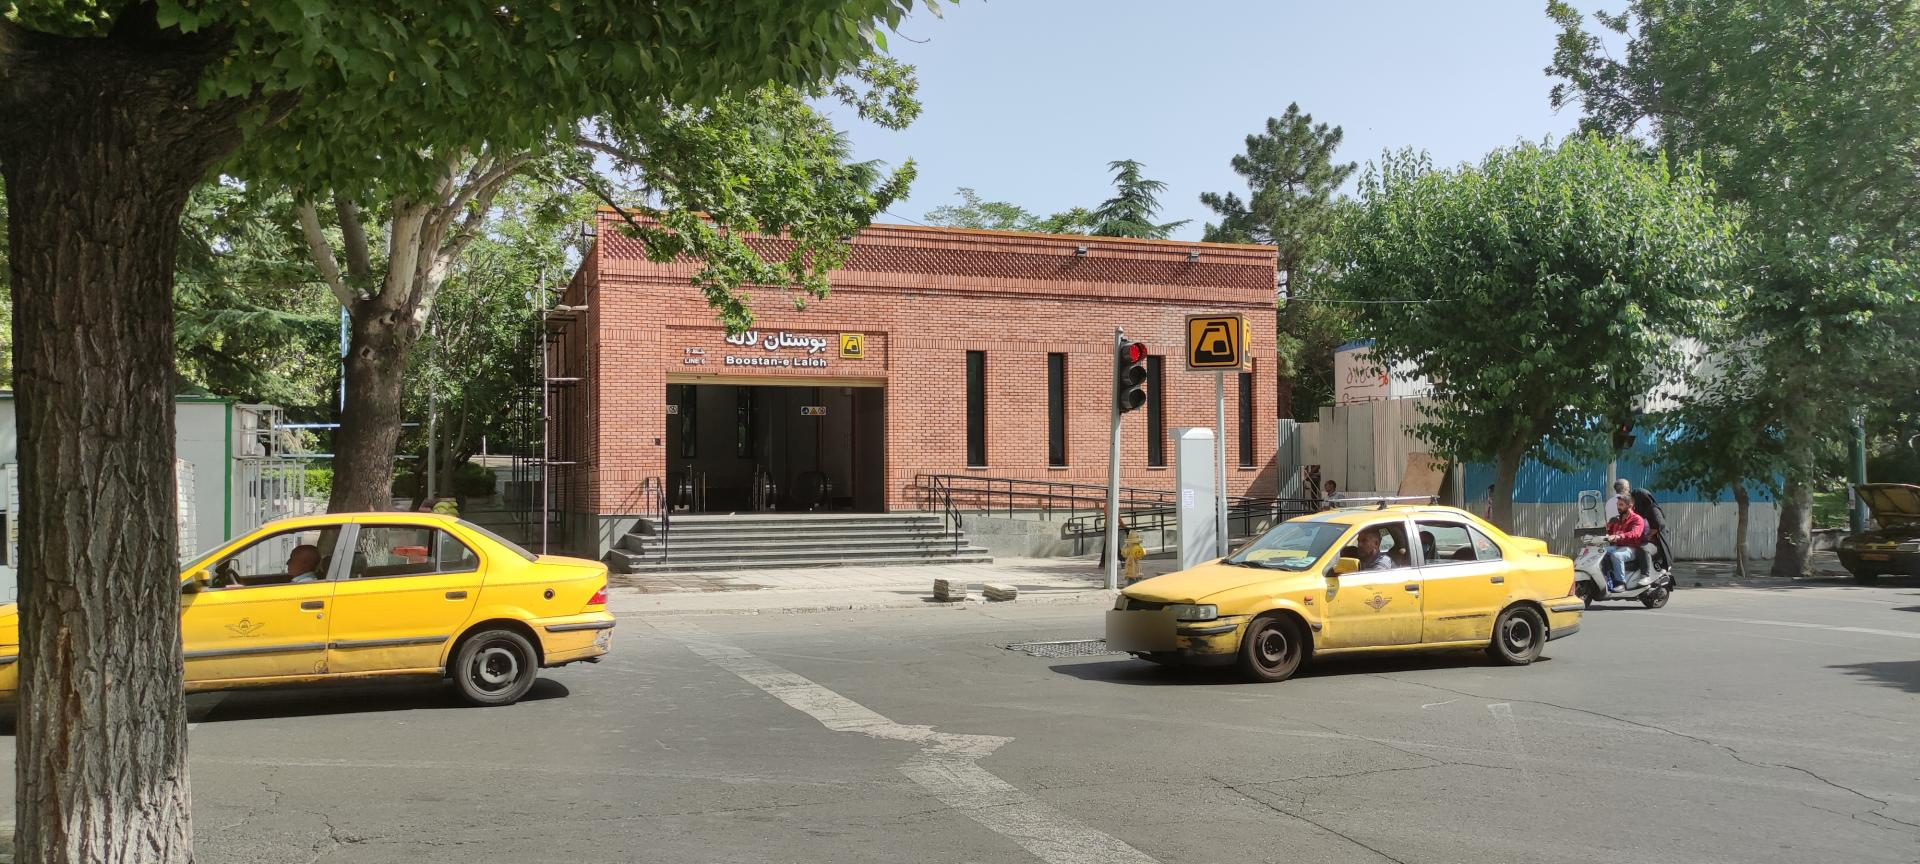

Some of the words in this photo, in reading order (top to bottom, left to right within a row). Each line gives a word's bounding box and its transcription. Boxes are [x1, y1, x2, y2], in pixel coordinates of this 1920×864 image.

[764, 331, 827, 354] بوستان
[726, 356, 790, 366] Boostan-e
[794, 357, 827, 367] Laleh
